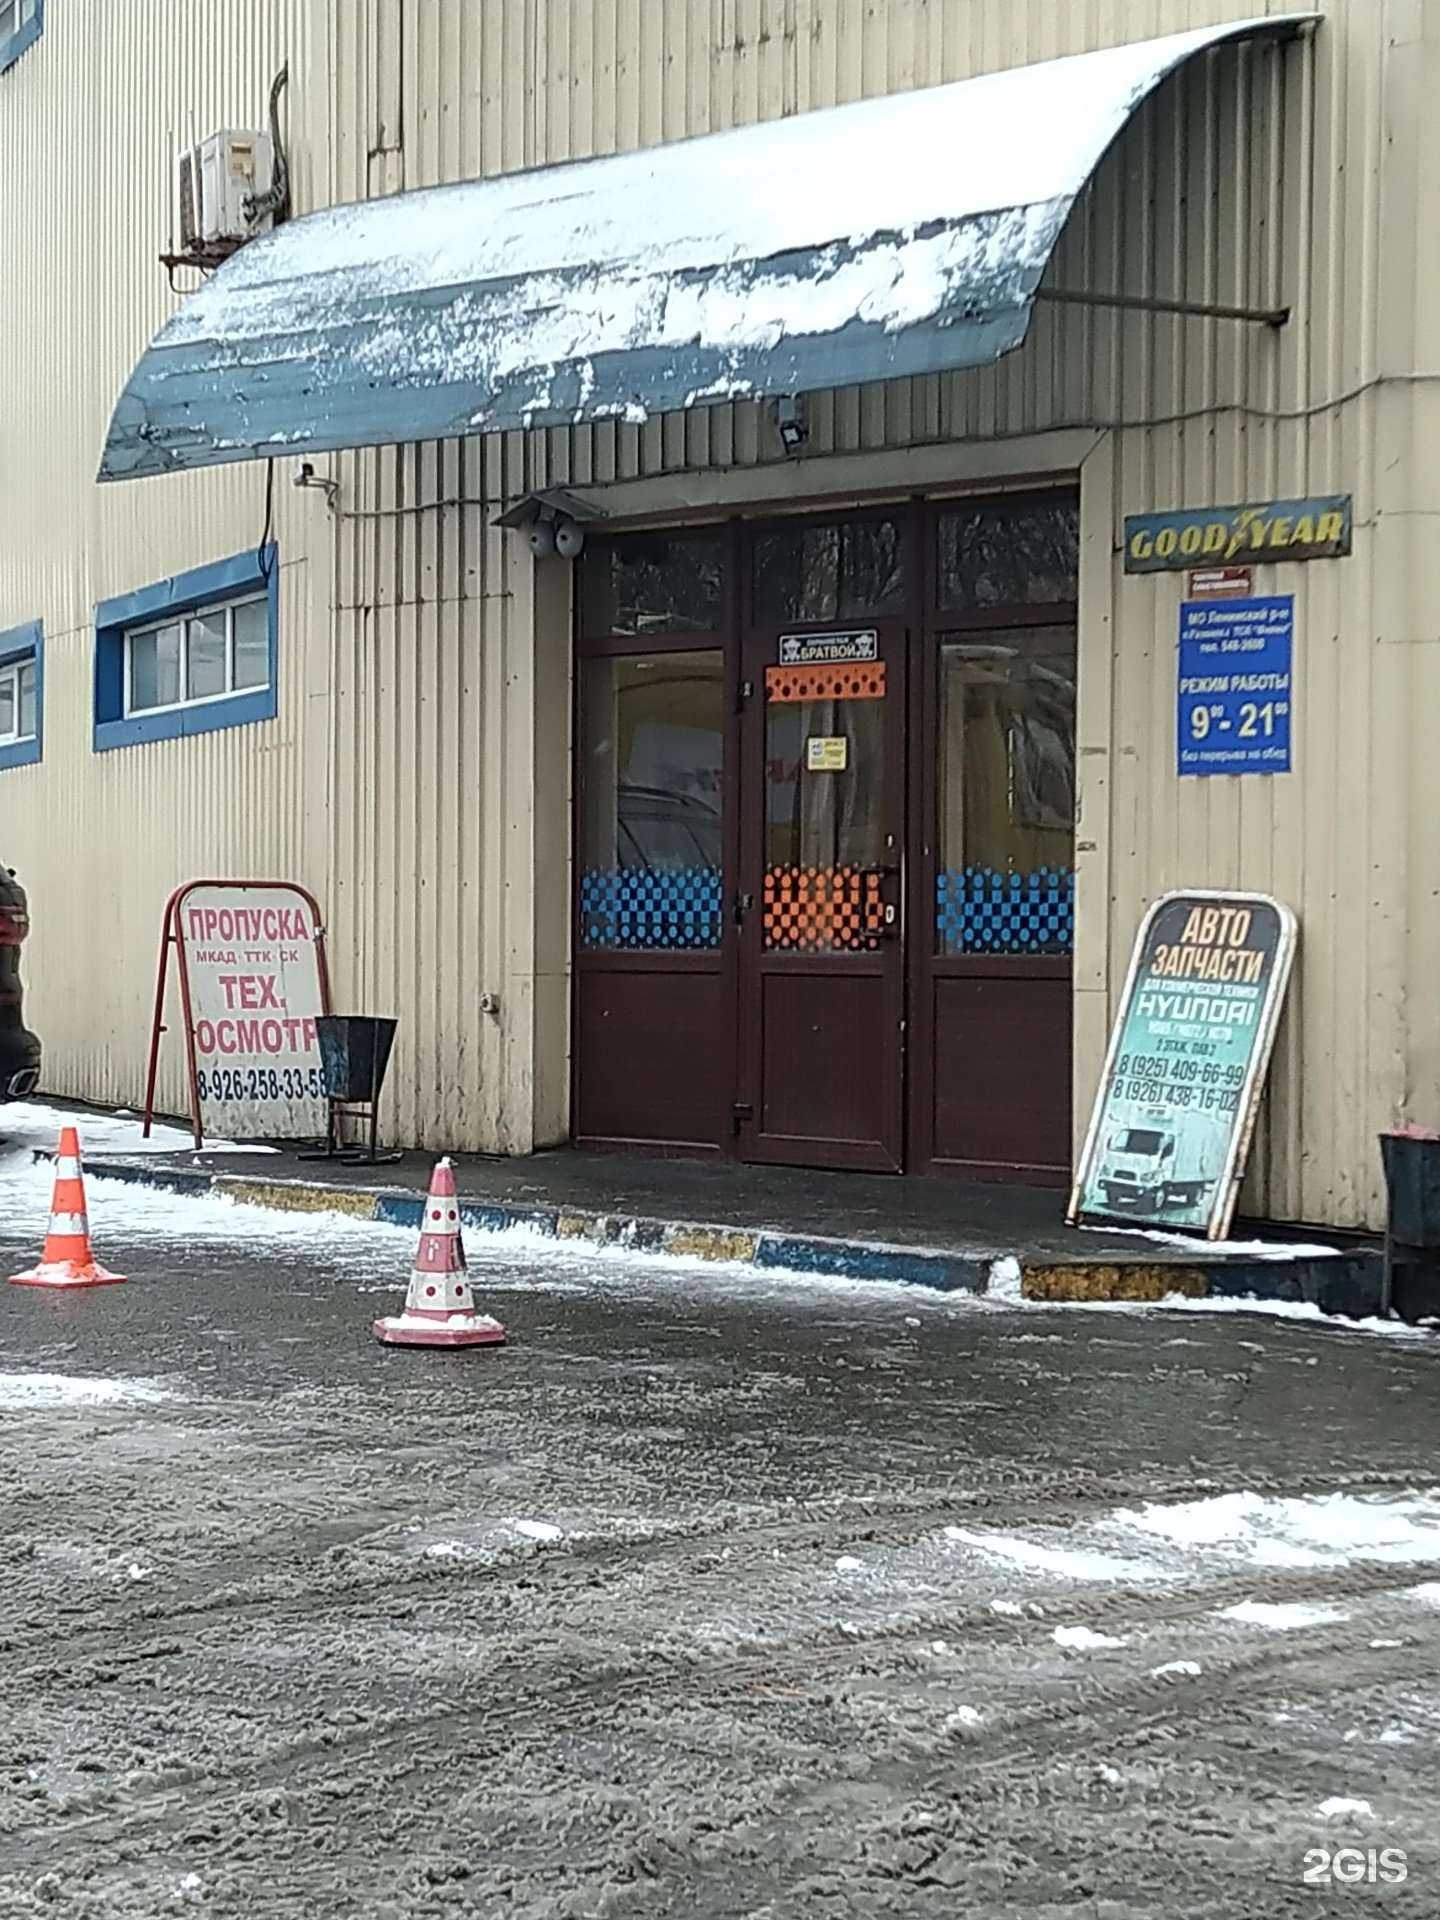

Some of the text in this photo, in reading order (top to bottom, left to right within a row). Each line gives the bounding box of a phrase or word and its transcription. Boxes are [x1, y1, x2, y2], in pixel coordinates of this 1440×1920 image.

[801, 643, 856, 660] БРАТВОЙ
[1180, 673, 1289, 694] РЕЖИМ РАБОТЫ
[188, 908, 309, 942] ПРОПУСКА
[1180, 906, 1252, 947] АВТО
[196, 949, 299, 965] МКАД ТТК СК
[1151, 944, 1266, 984] ЗАПЧАСТИ
[218, 975, 287, 1010] ТЕХ.
[1136, 993, 1256, 1026] HYUNDAI
[197, 1018, 317, 1054] ОСМОТР
[1118, 1054, 1244, 1087] 8 (925) 409-66-99
[1113, 1079, 1124, 1099] 8
[1125, 1080, 1163, 1103] (926)
